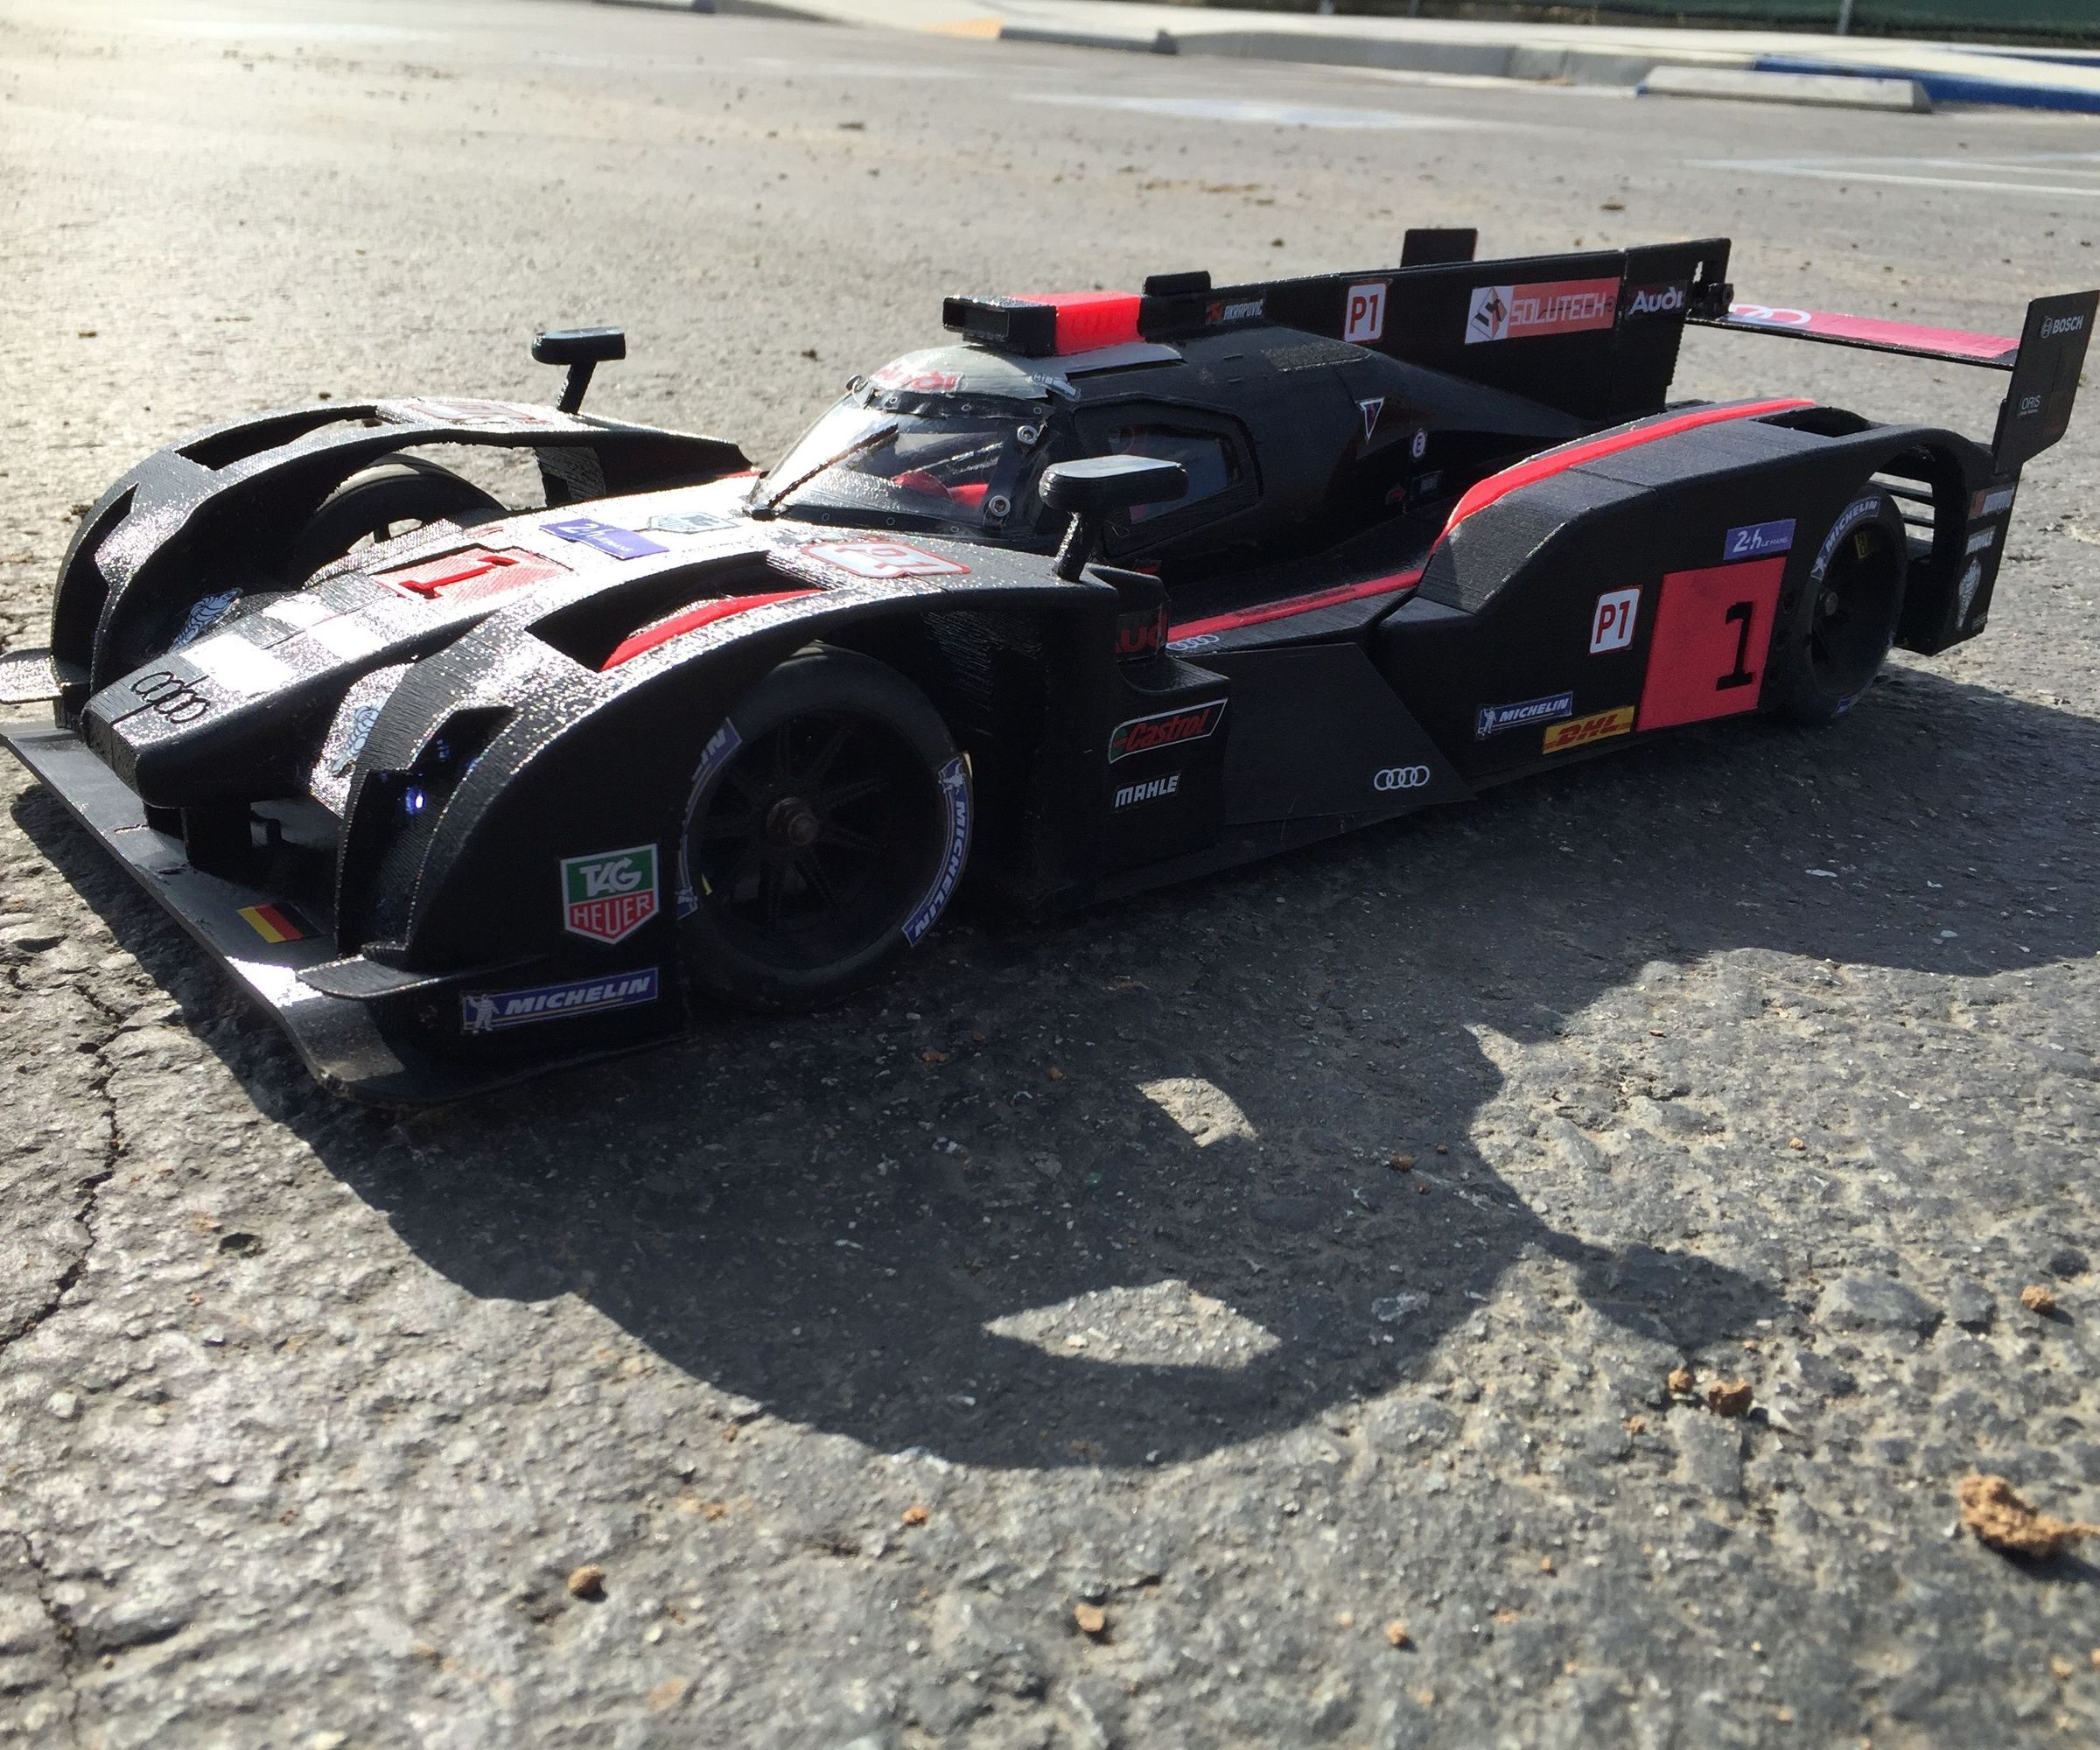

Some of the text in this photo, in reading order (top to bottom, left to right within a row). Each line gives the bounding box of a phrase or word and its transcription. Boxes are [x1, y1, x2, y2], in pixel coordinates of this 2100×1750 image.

[1349, 294, 1378, 334] P1
[1509, 292, 1606, 326] SOLUTECH
[2052, 316, 2084, 333] BOSCH
[1825, 500, 1878, 553] MICHELIN
[1595, 600, 1631, 645] P1
[1715, 600, 1754, 692] 1
[1126, 709, 1212, 752] Castrol
[1499, 698, 1570, 723] MICHELIN
[1556, 713, 1619, 746] DHL
[1115, 774, 1180, 808] MAHLE
[580, 857, 642, 898] TAG
[914, 800, 967, 938] MICHELIN
[572, 895, 651, 935] HEUER
[504, 976, 651, 1016] MICHELIN
